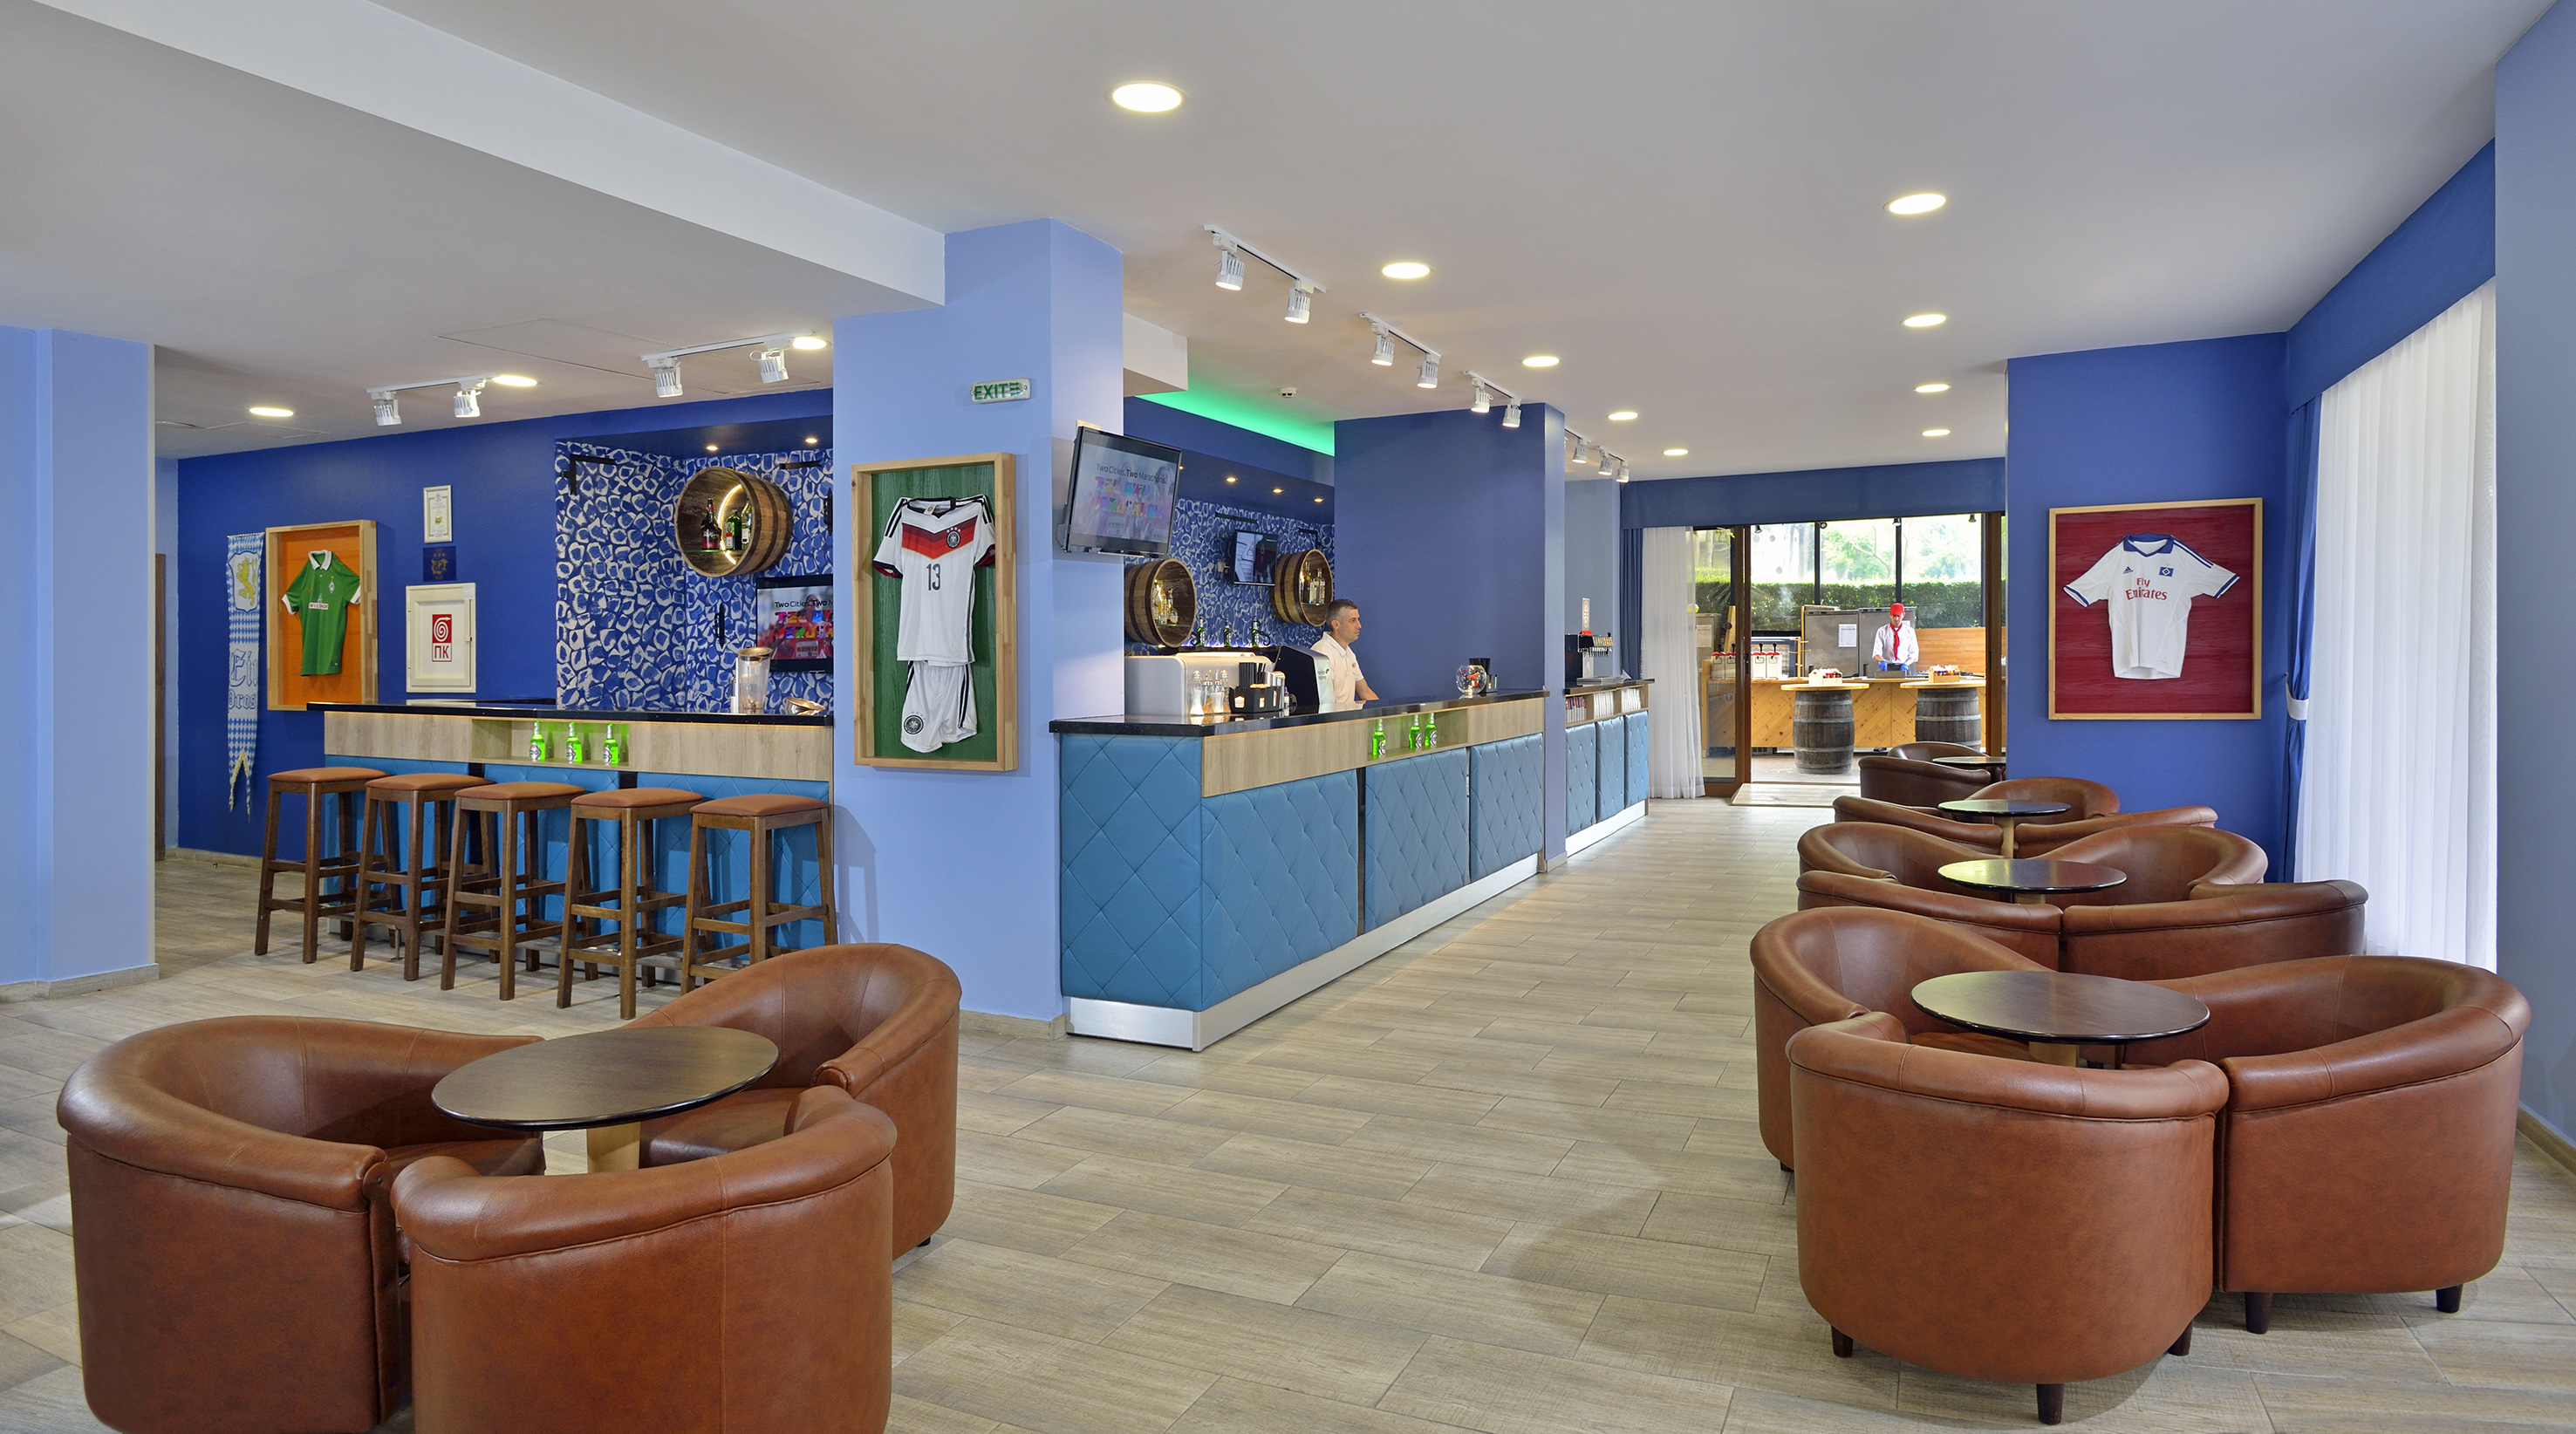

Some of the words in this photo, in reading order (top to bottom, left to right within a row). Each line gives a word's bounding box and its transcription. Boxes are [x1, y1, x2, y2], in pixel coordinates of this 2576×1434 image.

[974, 383, 1008, 400] EXIT
[1097, 463, 1109, 473] Two
[1126, 469, 1138, 479] Two
[926, 563, 940, 591] 13
[2136, 577, 2150, 587] Fly
[2125, 587, 2168, 600] Emirates
[775, 611, 808, 625] TEL
[775, 625, 833, 639] JERUSA
[434, 645, 449, 659] ПК
